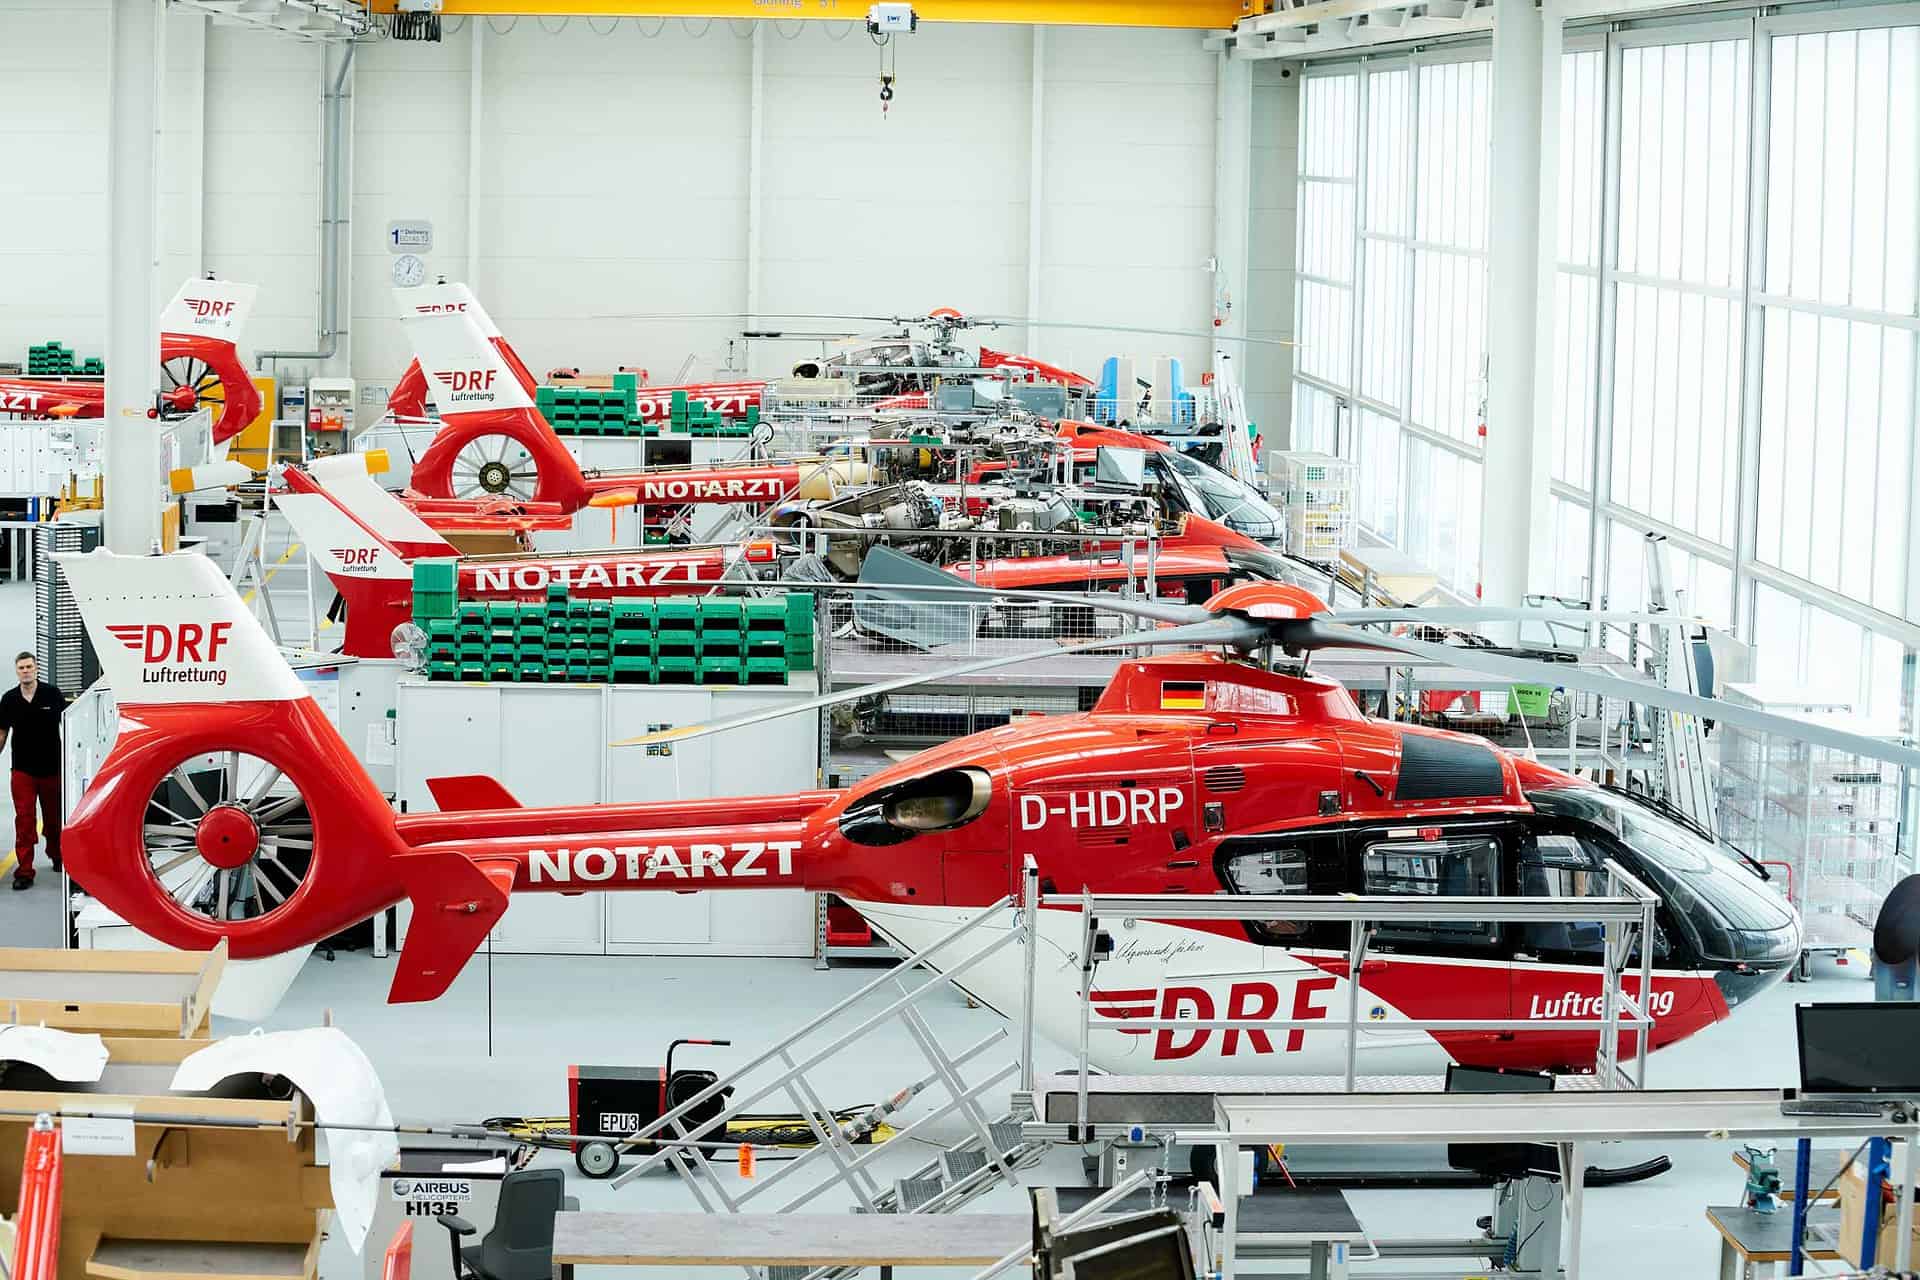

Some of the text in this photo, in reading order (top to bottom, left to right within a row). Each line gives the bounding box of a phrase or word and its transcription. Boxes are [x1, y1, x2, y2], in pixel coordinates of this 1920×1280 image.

[197, 300, 236, 316] DRF
[452, 370, 497, 391] DRF
[451, 392, 495, 402] Luftrettung
[644, 479, 781, 499] NOTARZT
[344, 548, 380, 564] DRF
[475, 560, 707, 591] NOTARZT
[144, 622, 233, 663] DRF
[143, 666, 228, 686] Luftrettung
[1020, 788, 1184, 831] D-HDRP
[528, 841, 803, 883] NOTARZT
[1154, 977, 1338, 1060] DRF
[601, 1114, 638, 1131] EPU3
[413, 1182, 470, 1193] AIRBUS
[406, 1201, 459, 1216] H135
